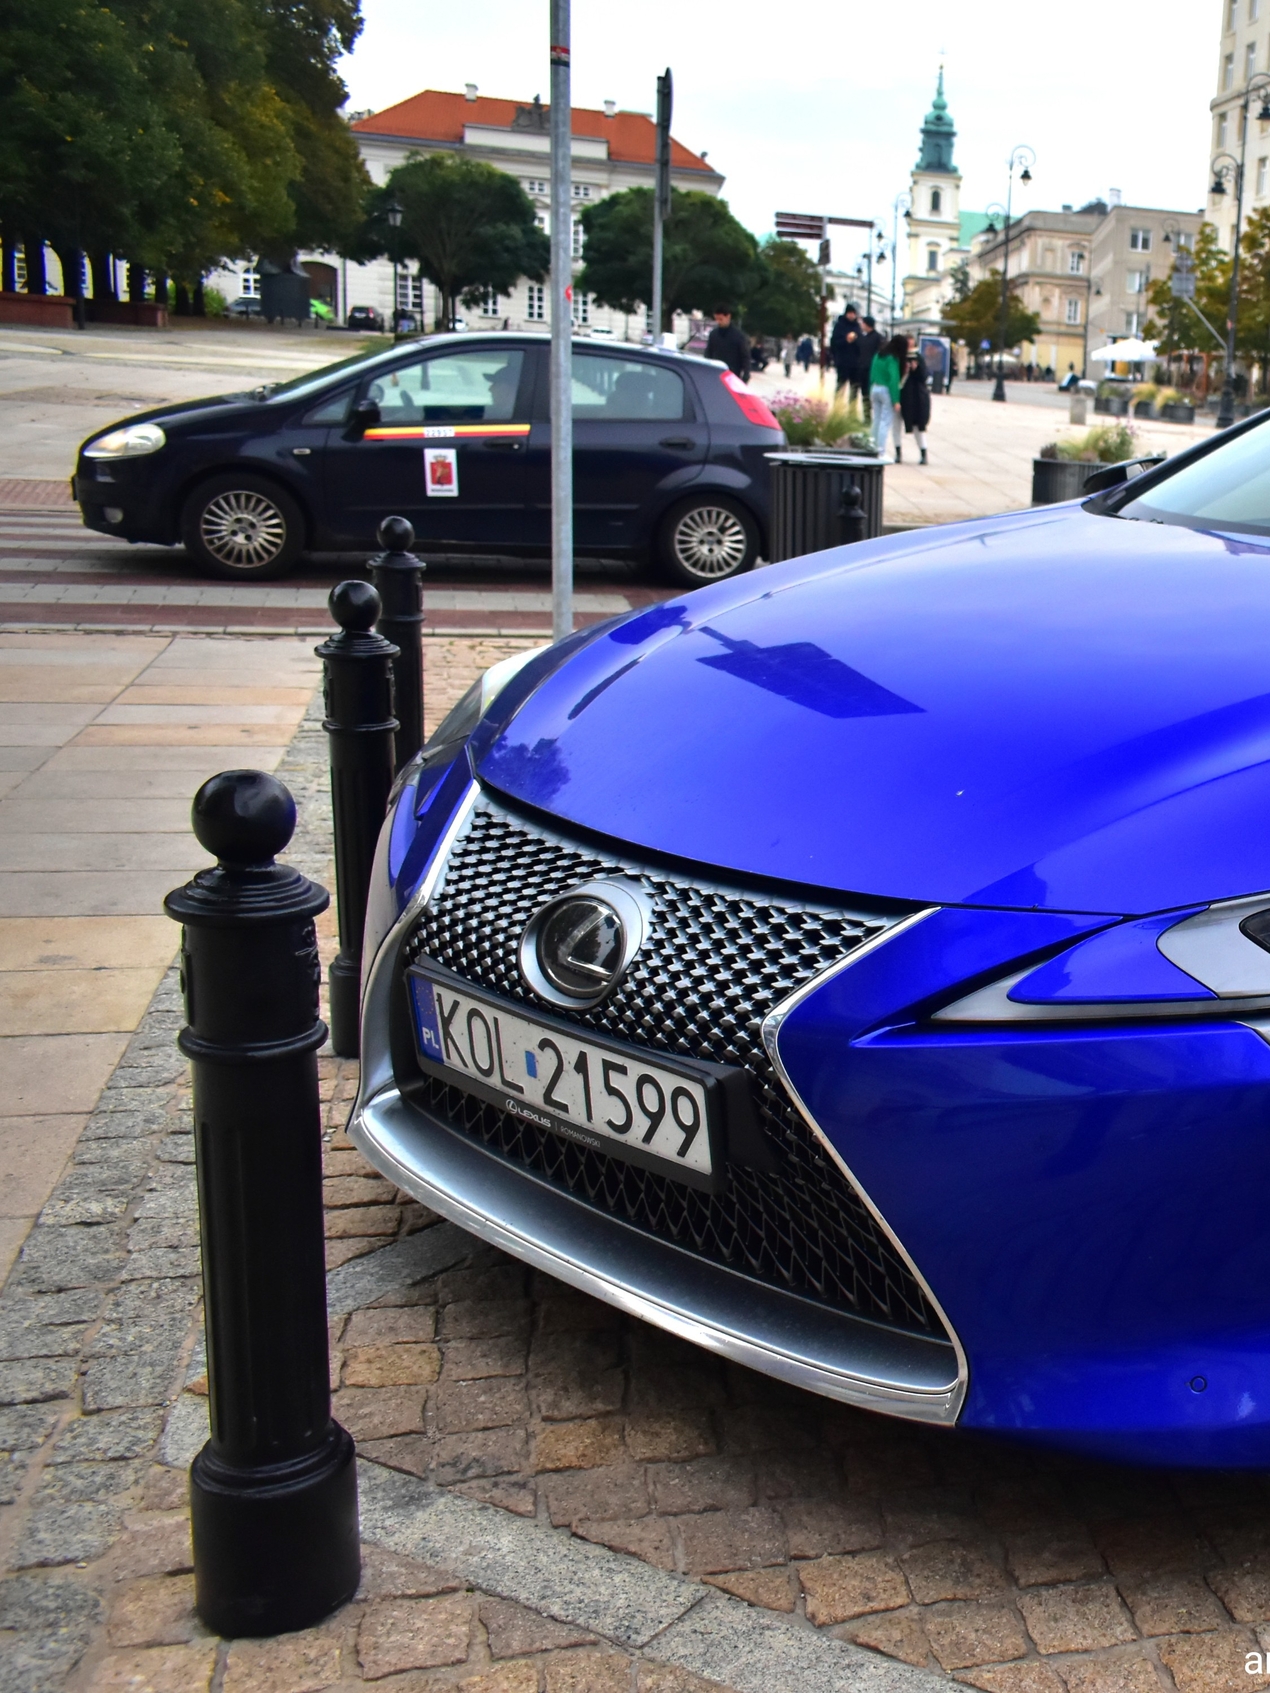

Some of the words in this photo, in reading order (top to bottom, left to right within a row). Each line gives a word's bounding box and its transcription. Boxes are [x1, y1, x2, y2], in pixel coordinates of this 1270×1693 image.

[422, 1026, 439, 1049] PL
[436, 992, 525, 1095] KOL
[537, 1037, 701, 1158] 21599
[518, 1106, 552, 1128] LEXUS
[560, 1125, 601, 1148] ROMANOWSKI
